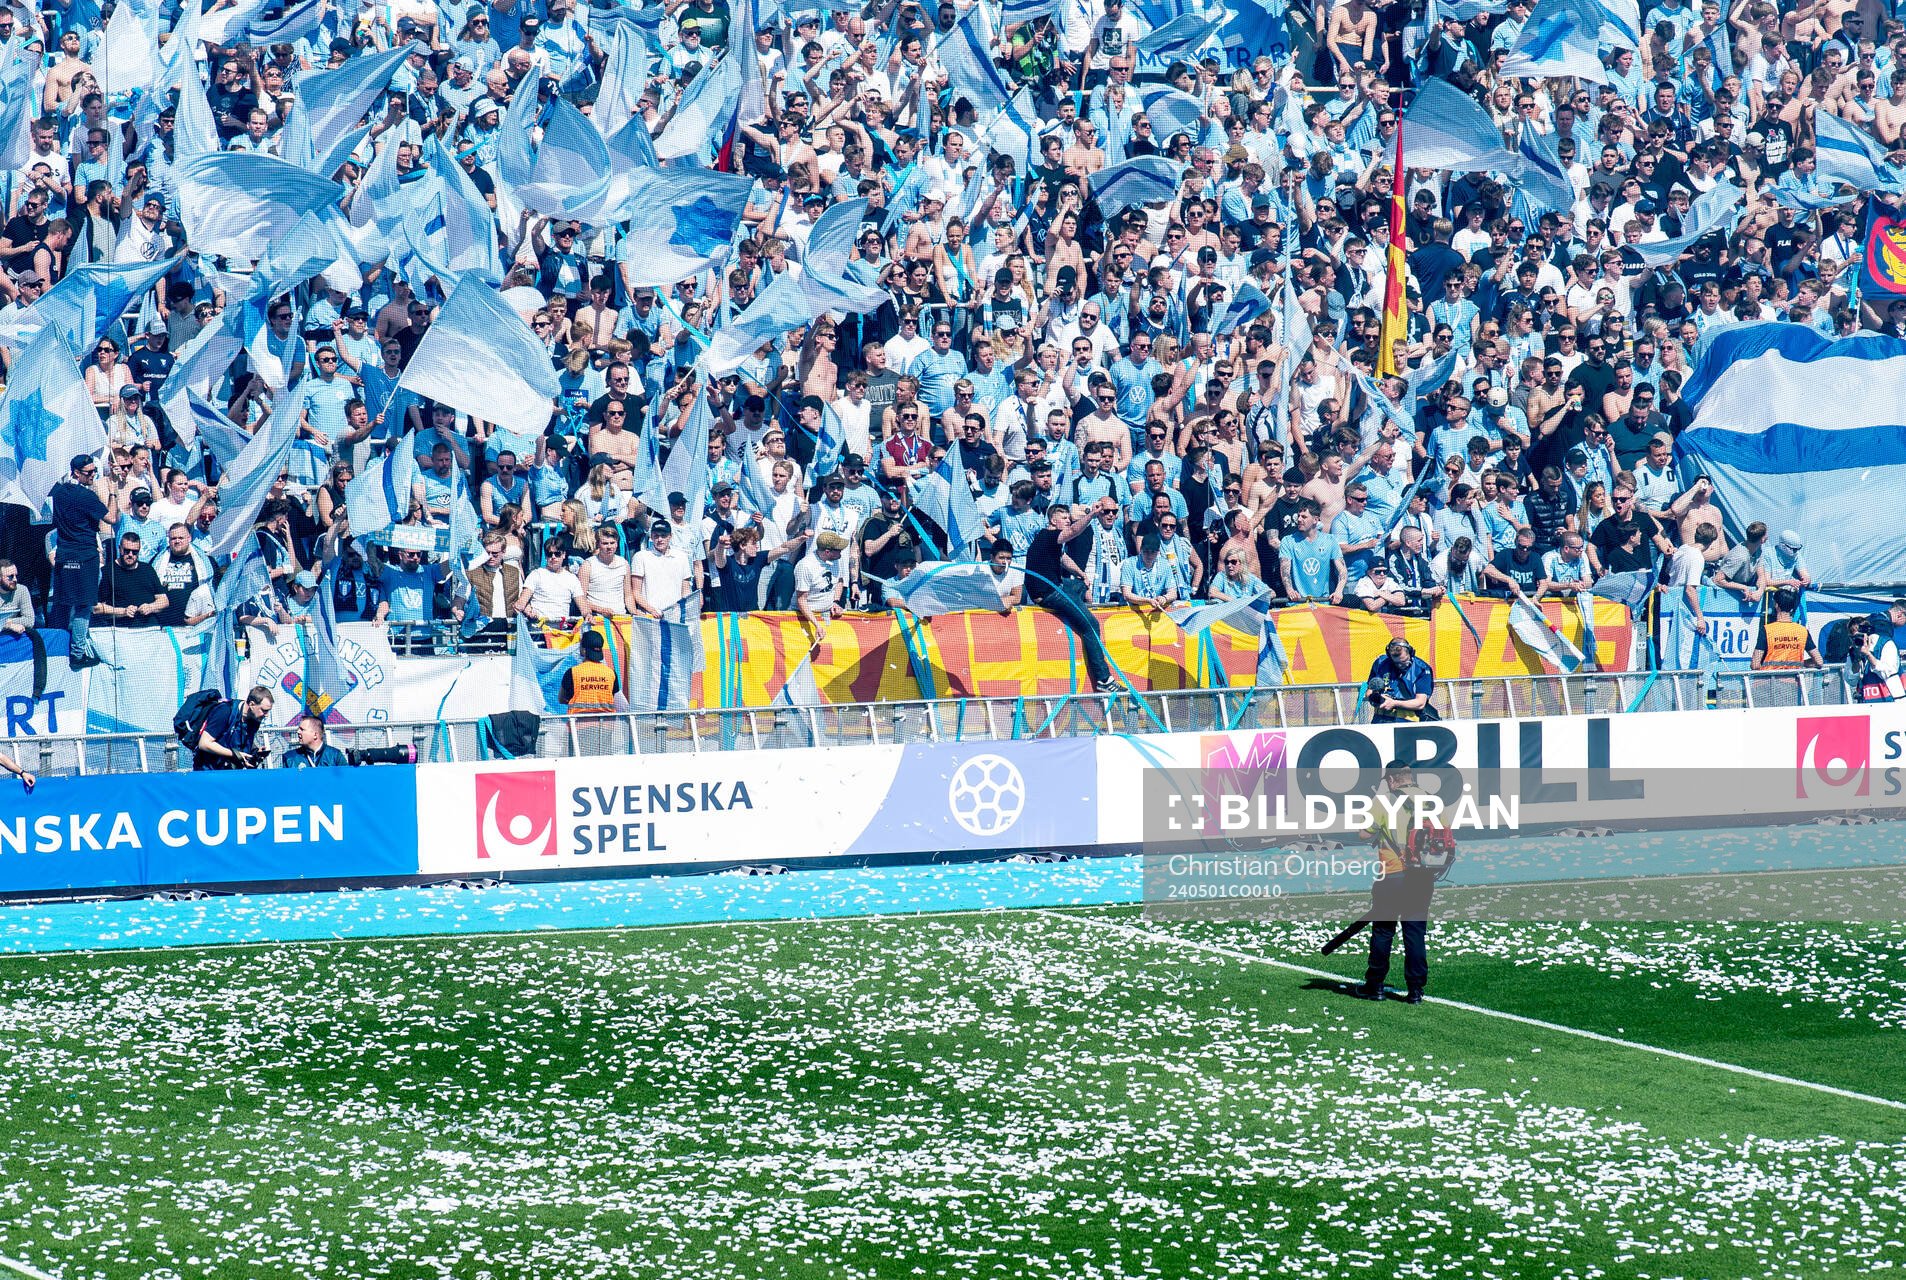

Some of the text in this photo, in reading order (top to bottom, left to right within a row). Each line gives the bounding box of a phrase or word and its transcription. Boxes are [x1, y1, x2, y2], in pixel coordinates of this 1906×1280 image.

[1200, 718, 1645, 836] MOBILL
[572, 781, 753, 817] SVENSKA
[0, 803, 344, 854] NSKA CUPEN
[573, 823, 667, 855] SPEL
